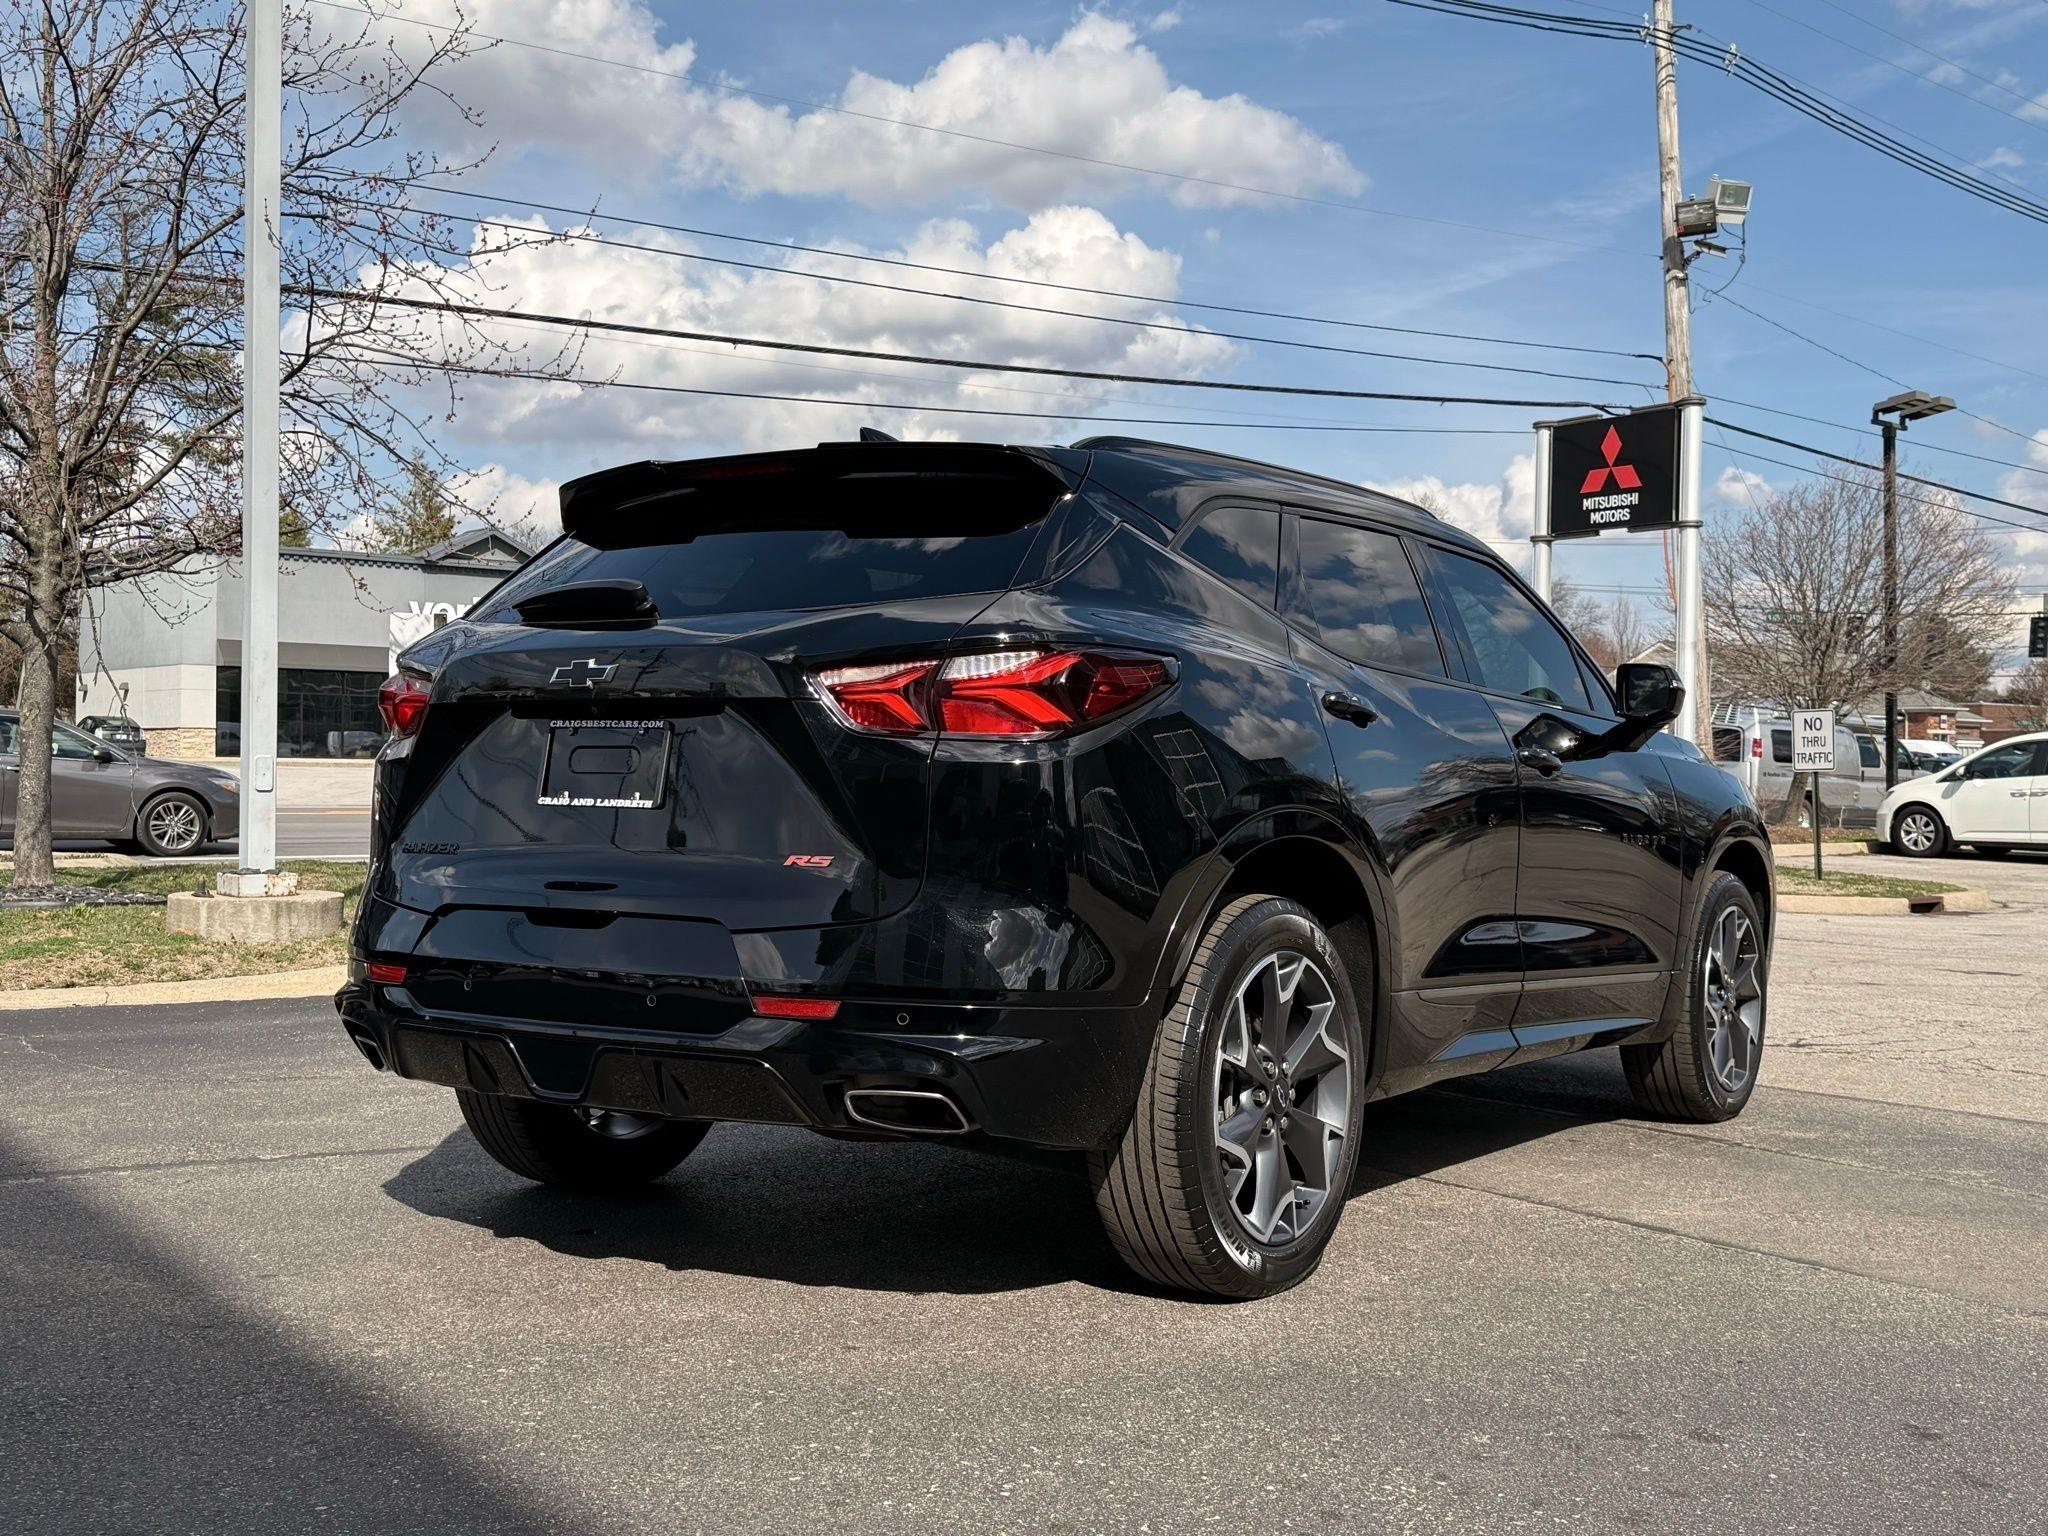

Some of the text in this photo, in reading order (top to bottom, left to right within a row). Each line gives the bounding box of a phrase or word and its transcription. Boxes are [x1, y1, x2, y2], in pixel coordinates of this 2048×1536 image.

[1583, 492, 1639, 510] MITSUBISHI
[1590, 508, 1630, 524] MOTORS
[550, 720, 664, 728] CRAIGSBESTCARS.COM
[1803, 717, 1823, 731] NO
[1801, 736, 1826, 747] THRU
[1796, 752, 1832, 764] TRAFFIC
[537, 797, 653, 808] CRAIG AND LANDRETH
[783, 854, 835, 868] RS
